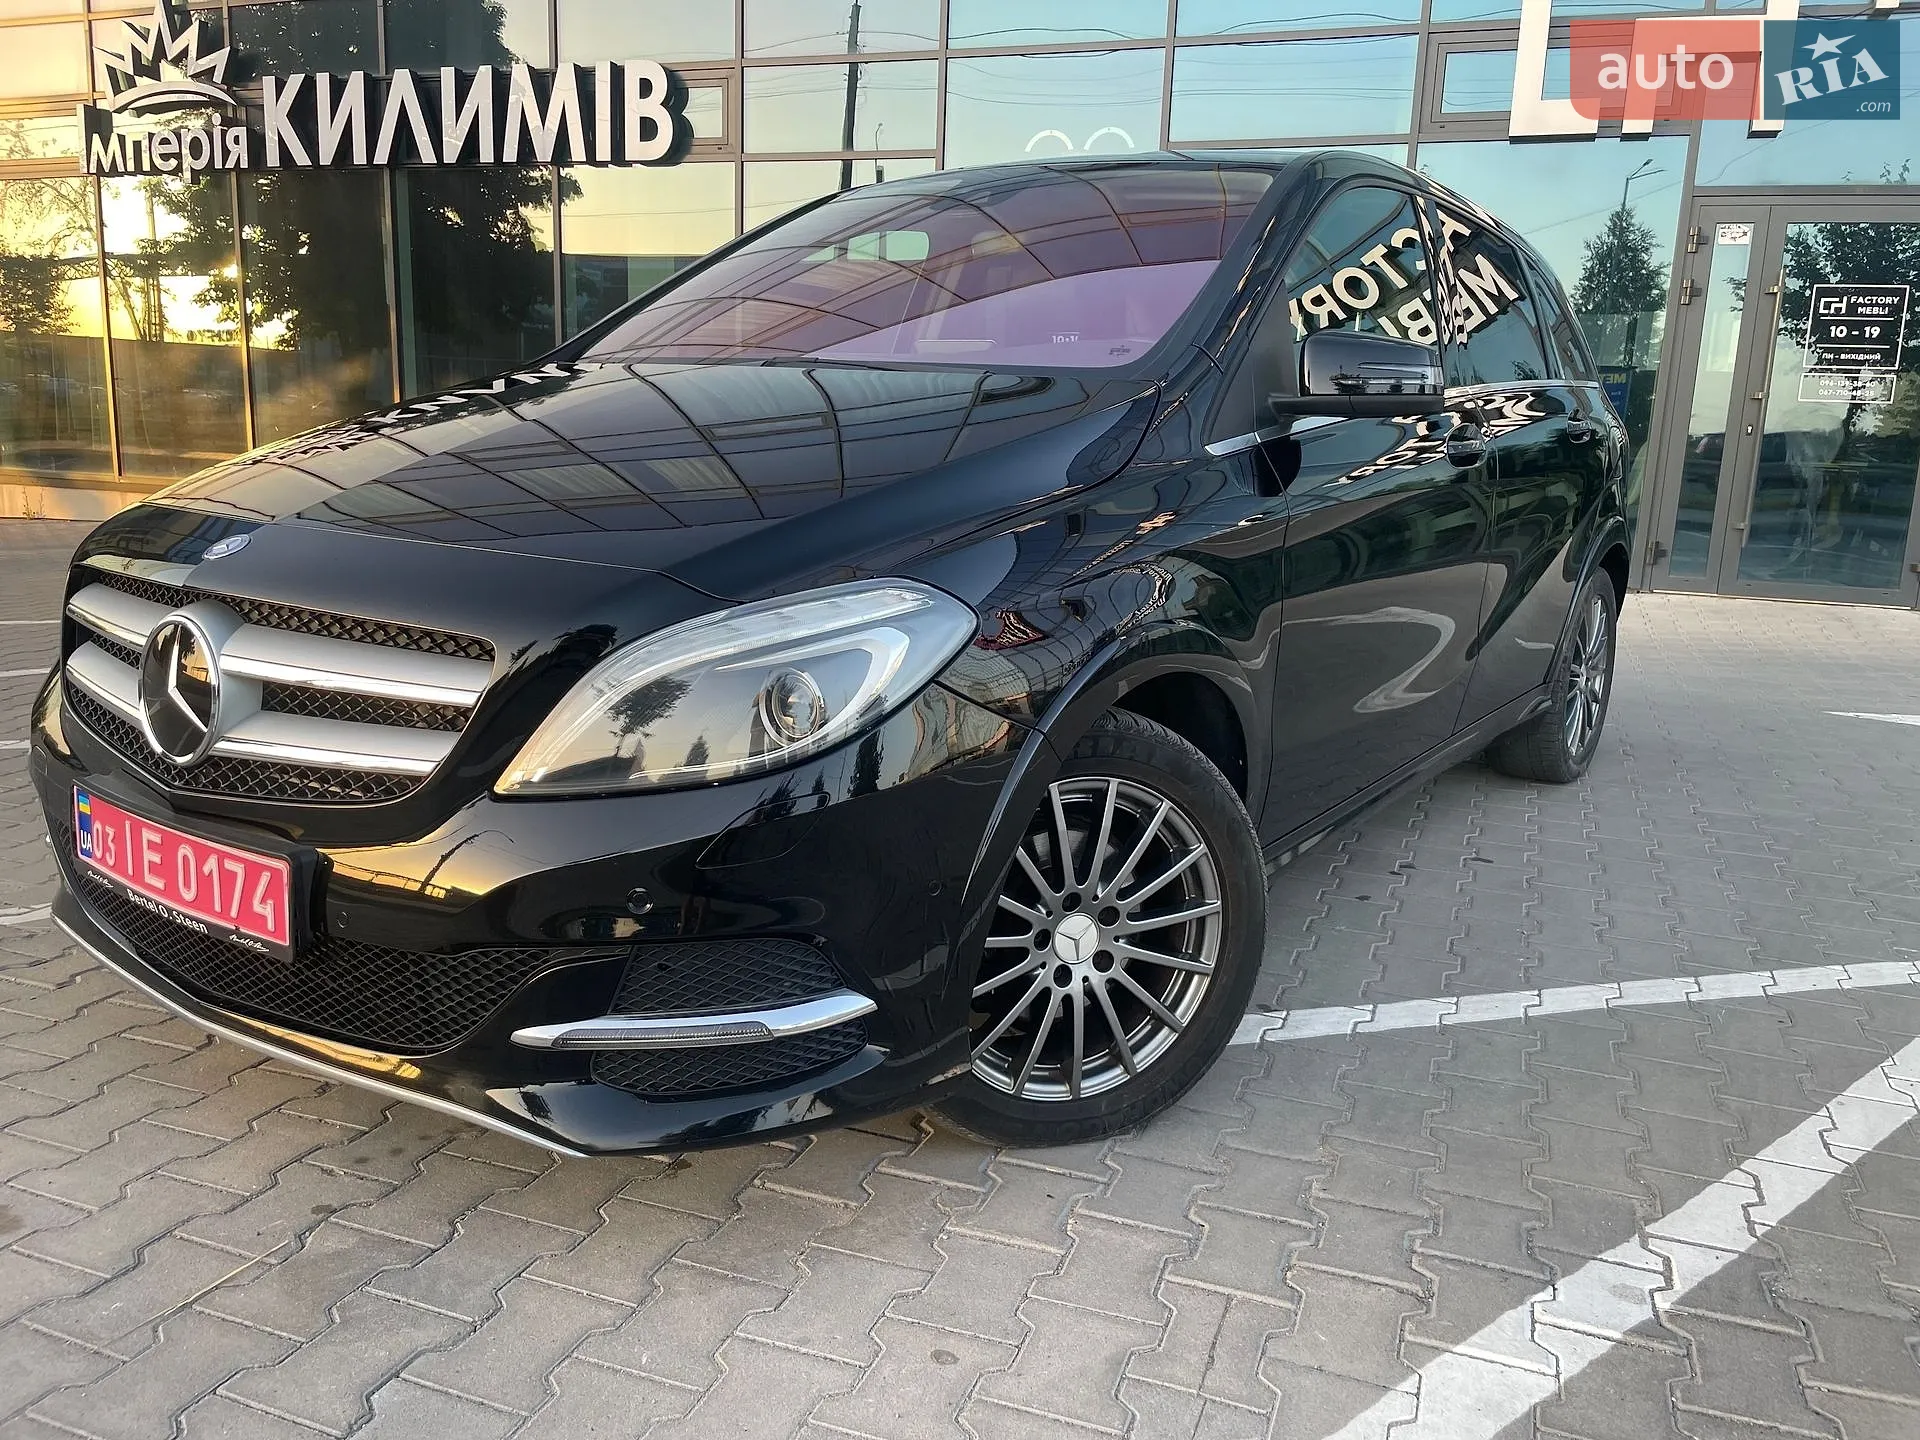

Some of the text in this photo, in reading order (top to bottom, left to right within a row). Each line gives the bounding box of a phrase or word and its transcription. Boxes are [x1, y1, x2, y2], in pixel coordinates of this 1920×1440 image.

[262, 59, 674, 168] КИЛИМІВ
[1850, 295, 1900, 305] FACTORY
[1829, 325, 1847, 338] 10
[1864, 326, 1881, 339] 19
[80, 829, 93, 853] UA
[93, 820, 116, 867] 03
[177, 843, 276, 933] 0174
[126, 888, 158, 914] Bertel
[175, 911, 209, 935] Steen
